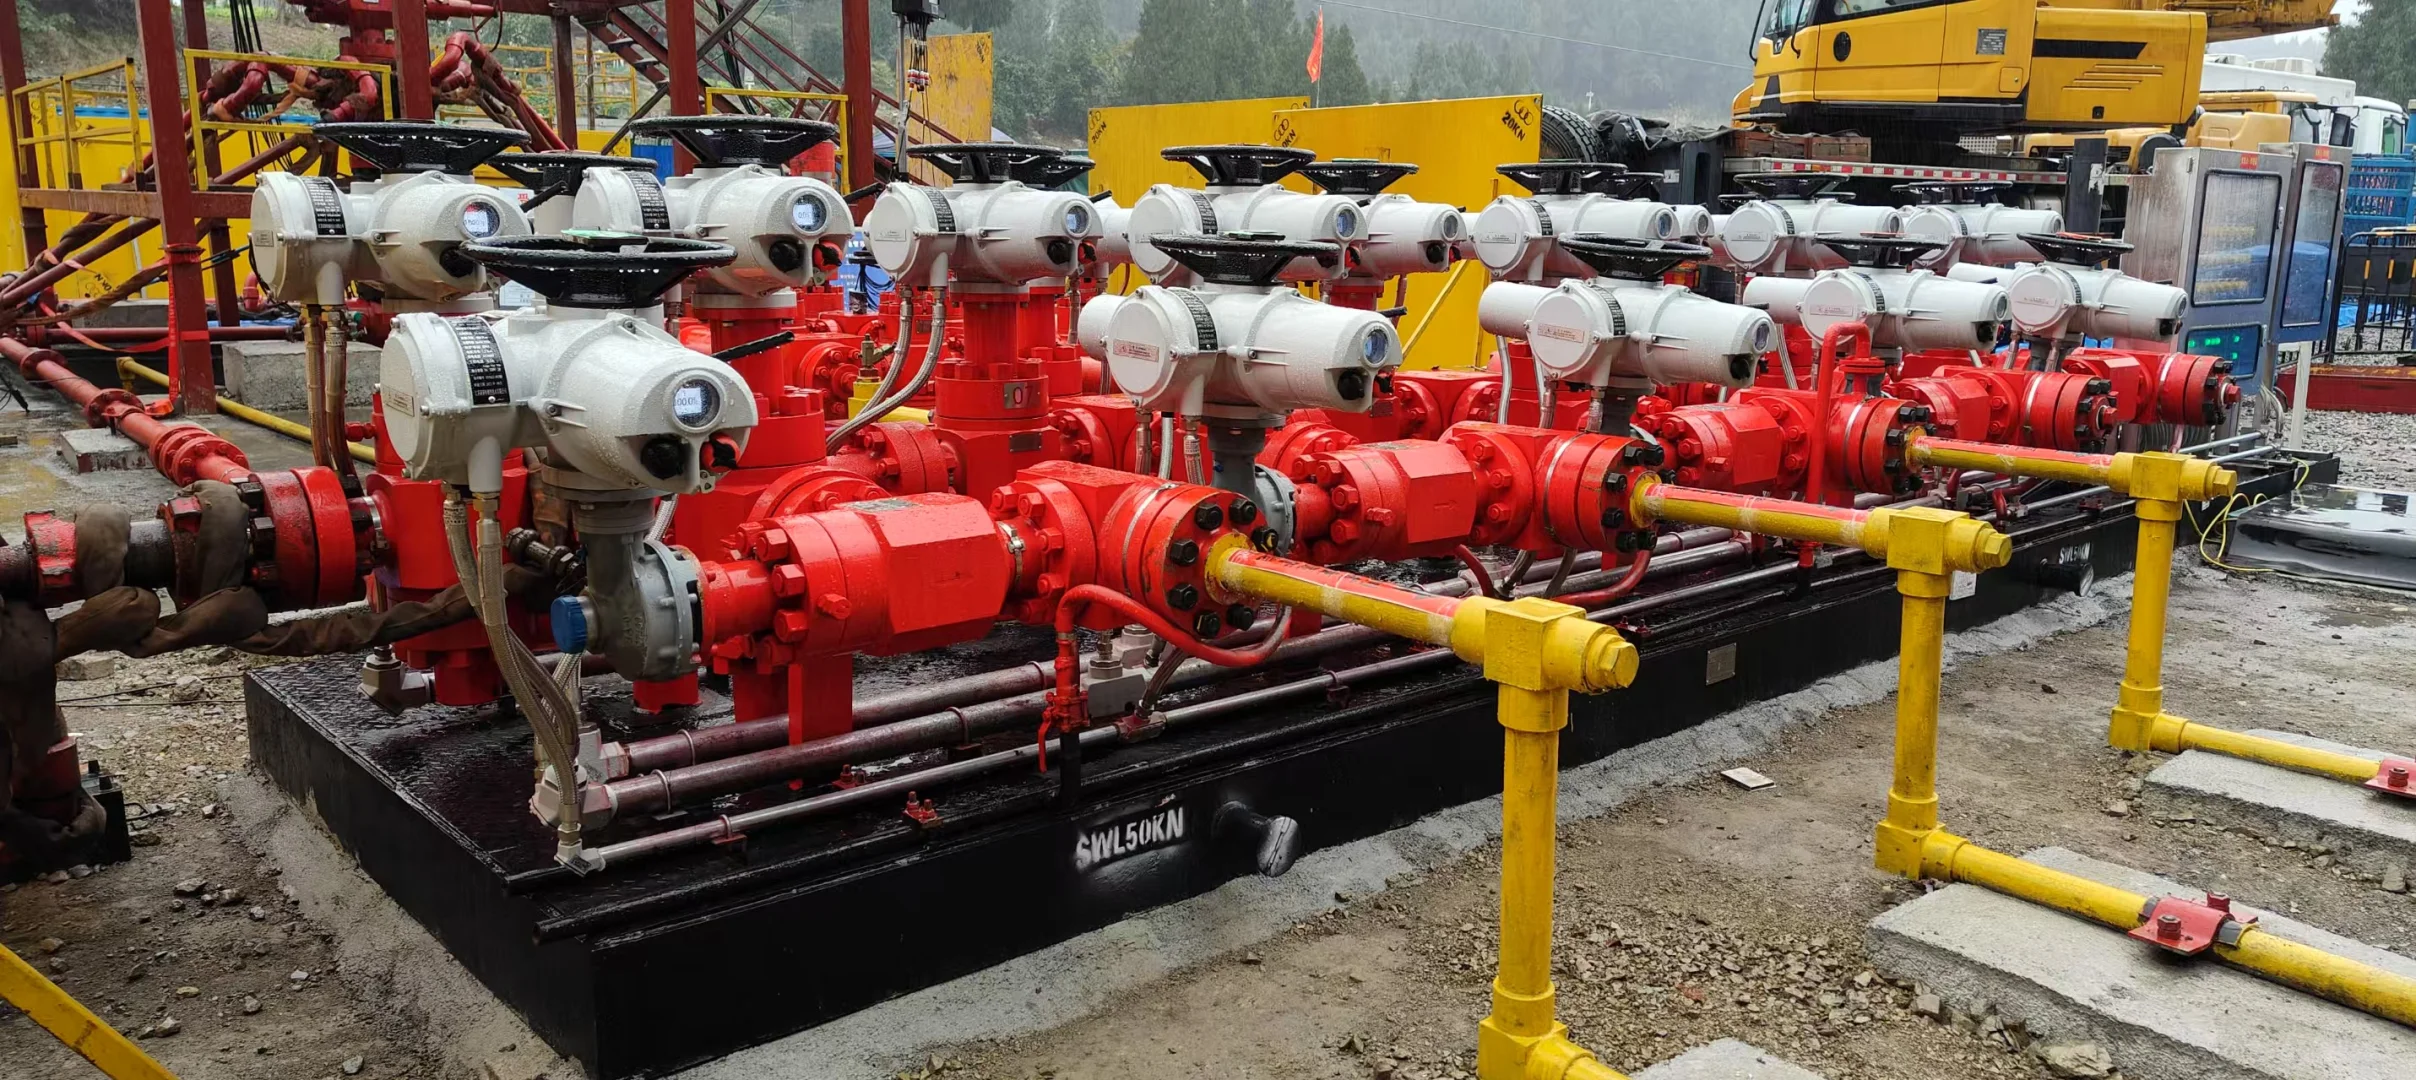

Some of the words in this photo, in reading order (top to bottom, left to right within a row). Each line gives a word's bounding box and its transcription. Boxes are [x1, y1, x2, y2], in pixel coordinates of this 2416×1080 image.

[1282, 129, 1297, 148] 0KN
[1501, 110, 1526, 142] 20KN
[1074, 806, 1185, 871] SWL50KN
